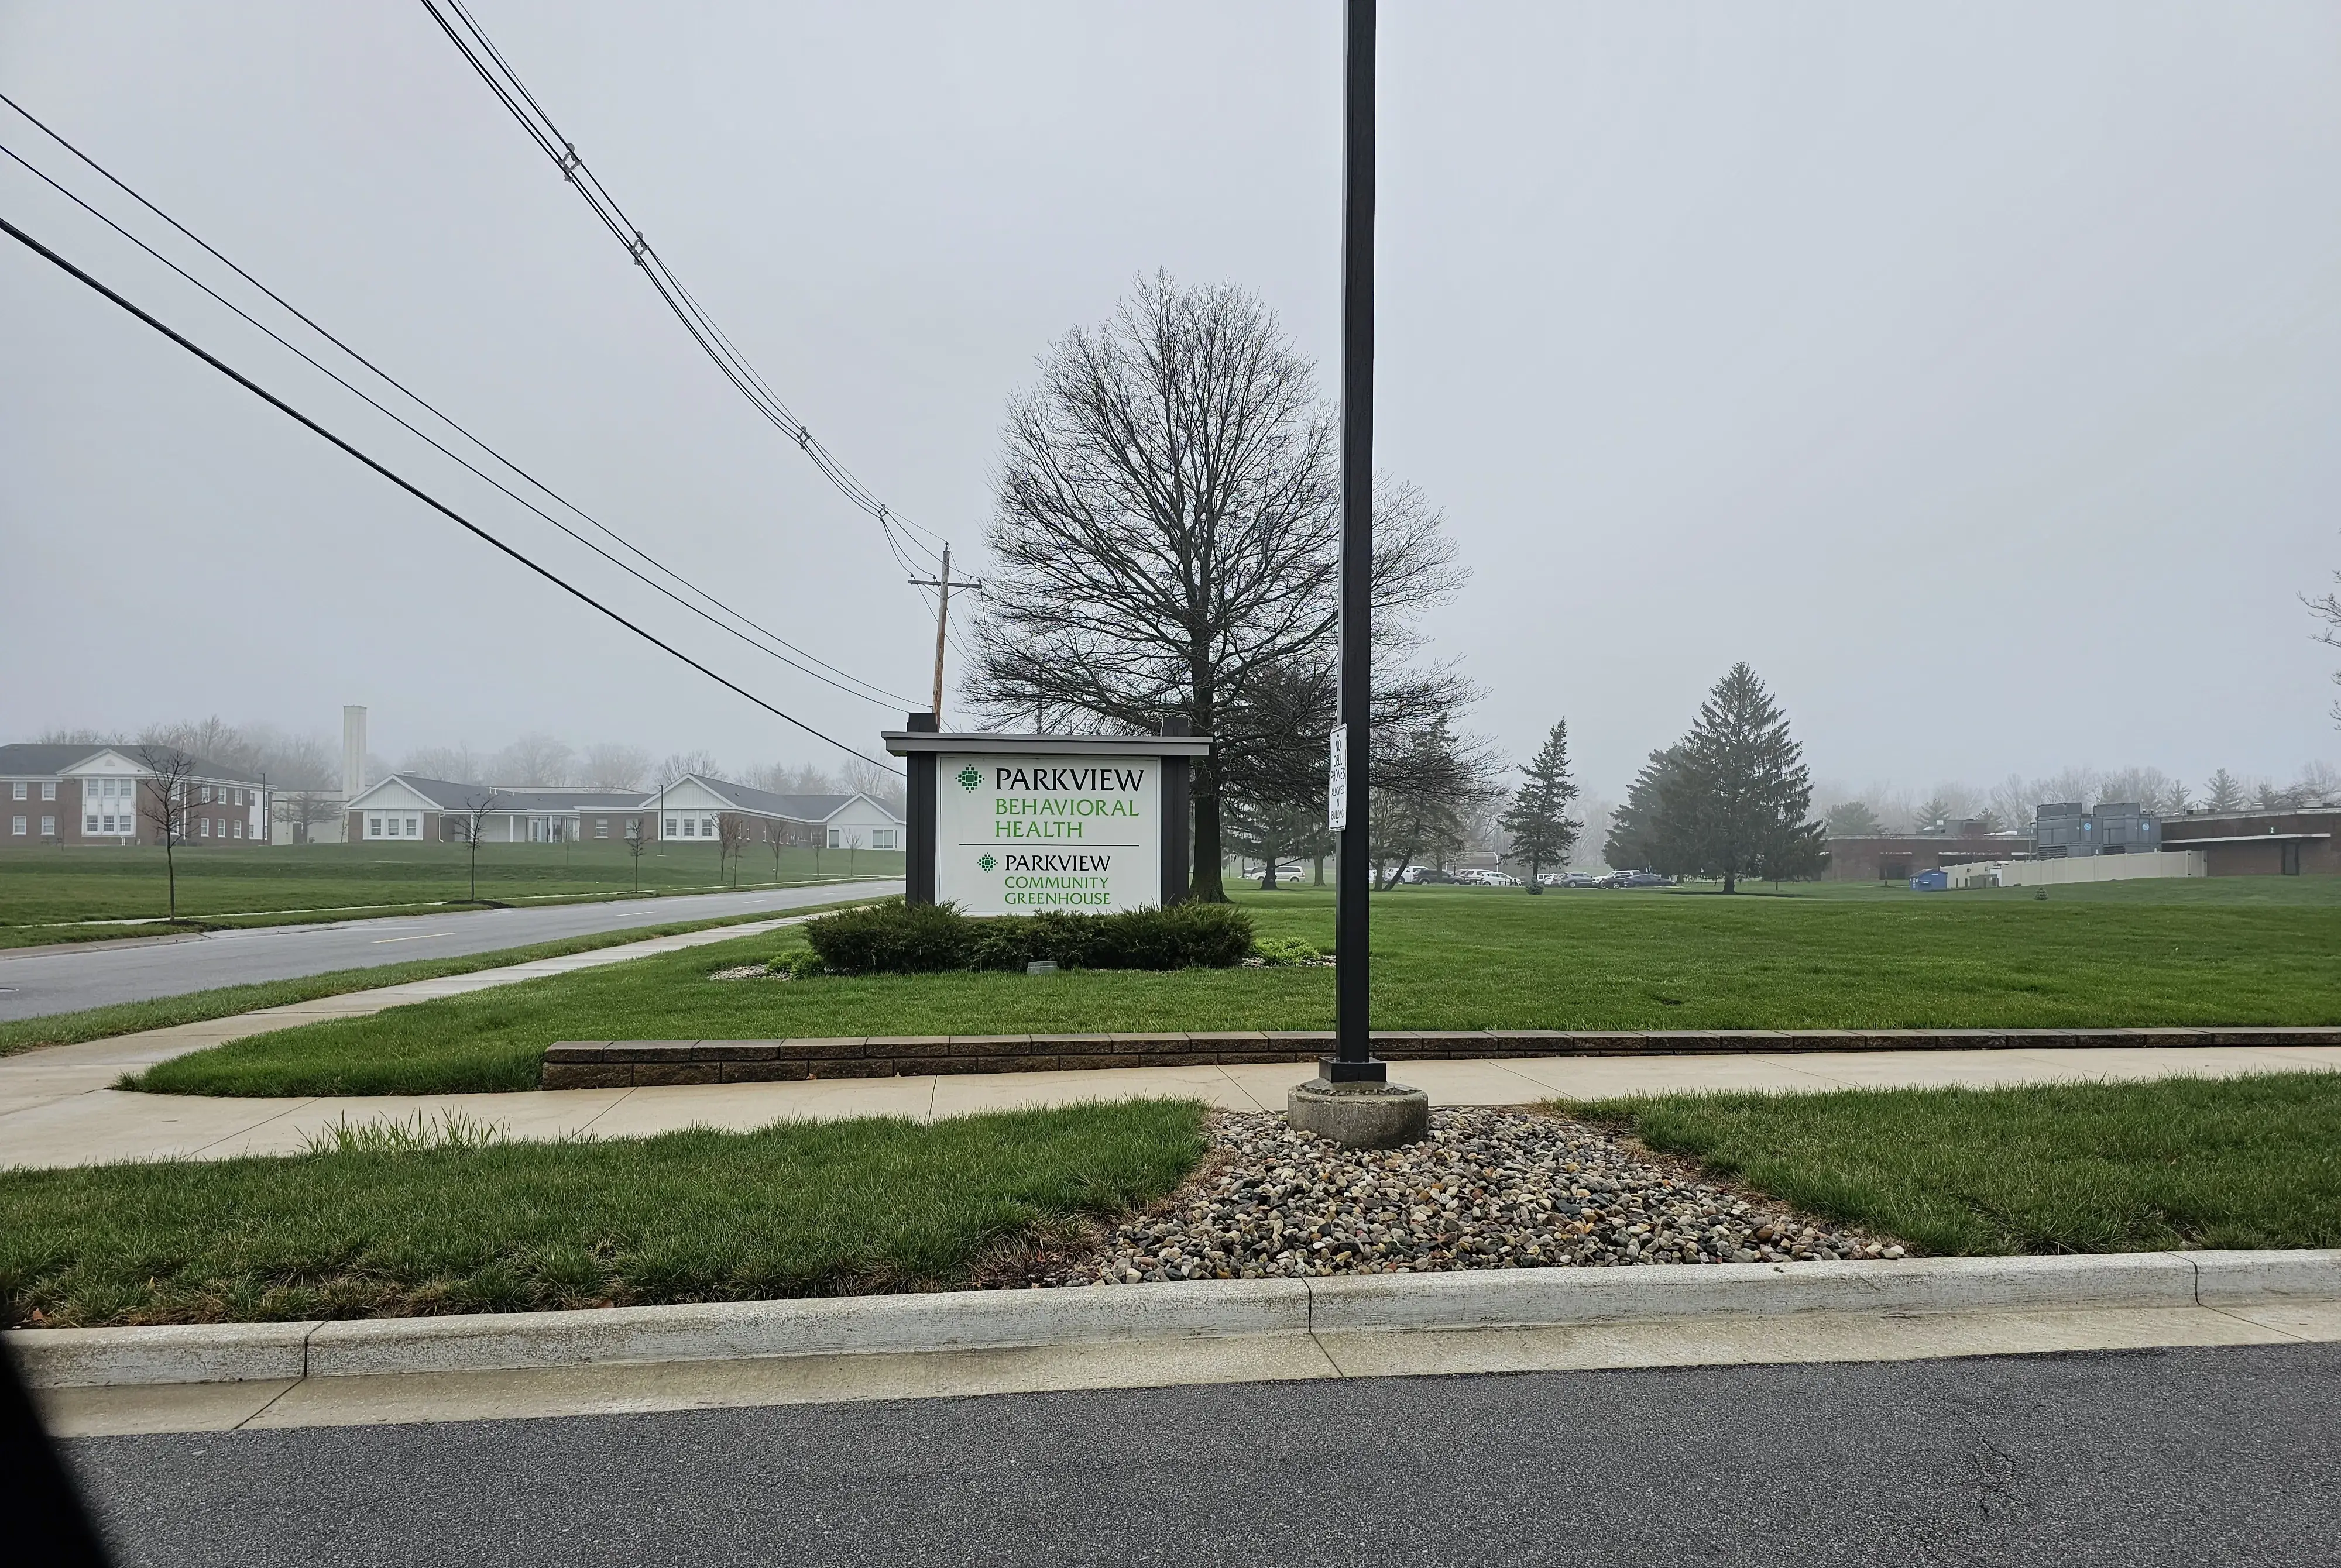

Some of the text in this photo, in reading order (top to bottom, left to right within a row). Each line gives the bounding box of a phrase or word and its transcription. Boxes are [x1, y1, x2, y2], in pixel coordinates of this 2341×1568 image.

[1335, 739, 1341, 753] NO
[1333, 754, 1343, 768] CELL
[996, 768, 1144, 792] PARKVIEW
[1331, 767, 1345, 782] PHONES
[1331, 785, 1344, 796] ALLOWED
[996, 799, 1139, 816] BEHAVIORAL
[1336, 797, 1340, 807] IN
[1331, 809, 1344, 820] BUILDING
[996, 821, 1082, 838] HEALTH
[1005, 855, 1111, 872] PARKVIEW
[1005, 876, 1109, 889] COMMUNITY
[1005, 892, 1111, 905] GREENHOUSE
